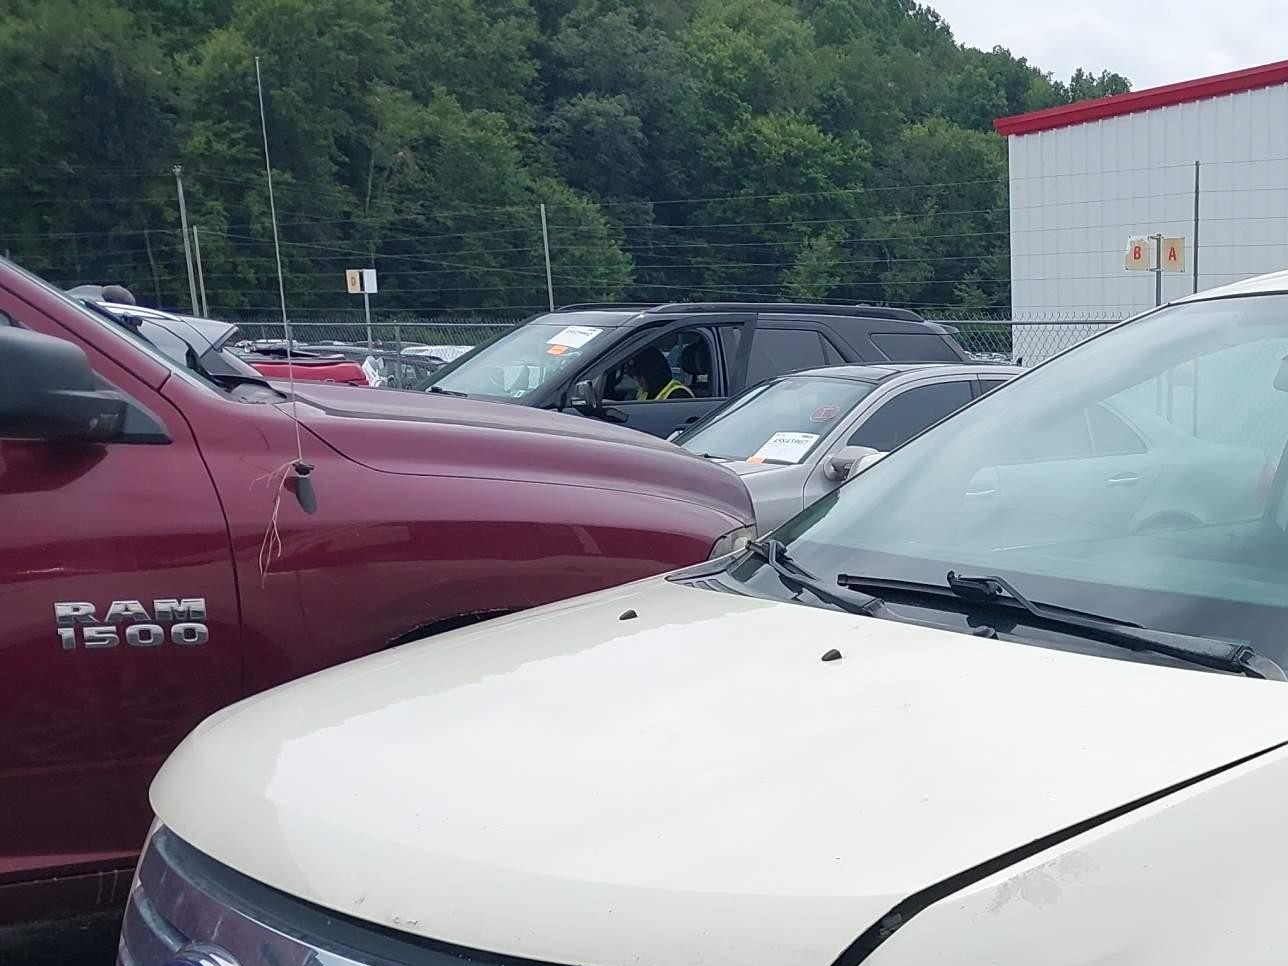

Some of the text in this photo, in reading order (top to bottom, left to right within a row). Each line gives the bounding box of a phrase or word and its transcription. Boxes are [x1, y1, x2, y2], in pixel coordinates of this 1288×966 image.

[1133, 246, 1142, 260] B
[1168, 246, 1177, 261] A
[54, 597, 207, 624] RAM
[57, 622, 209, 649] 1500
